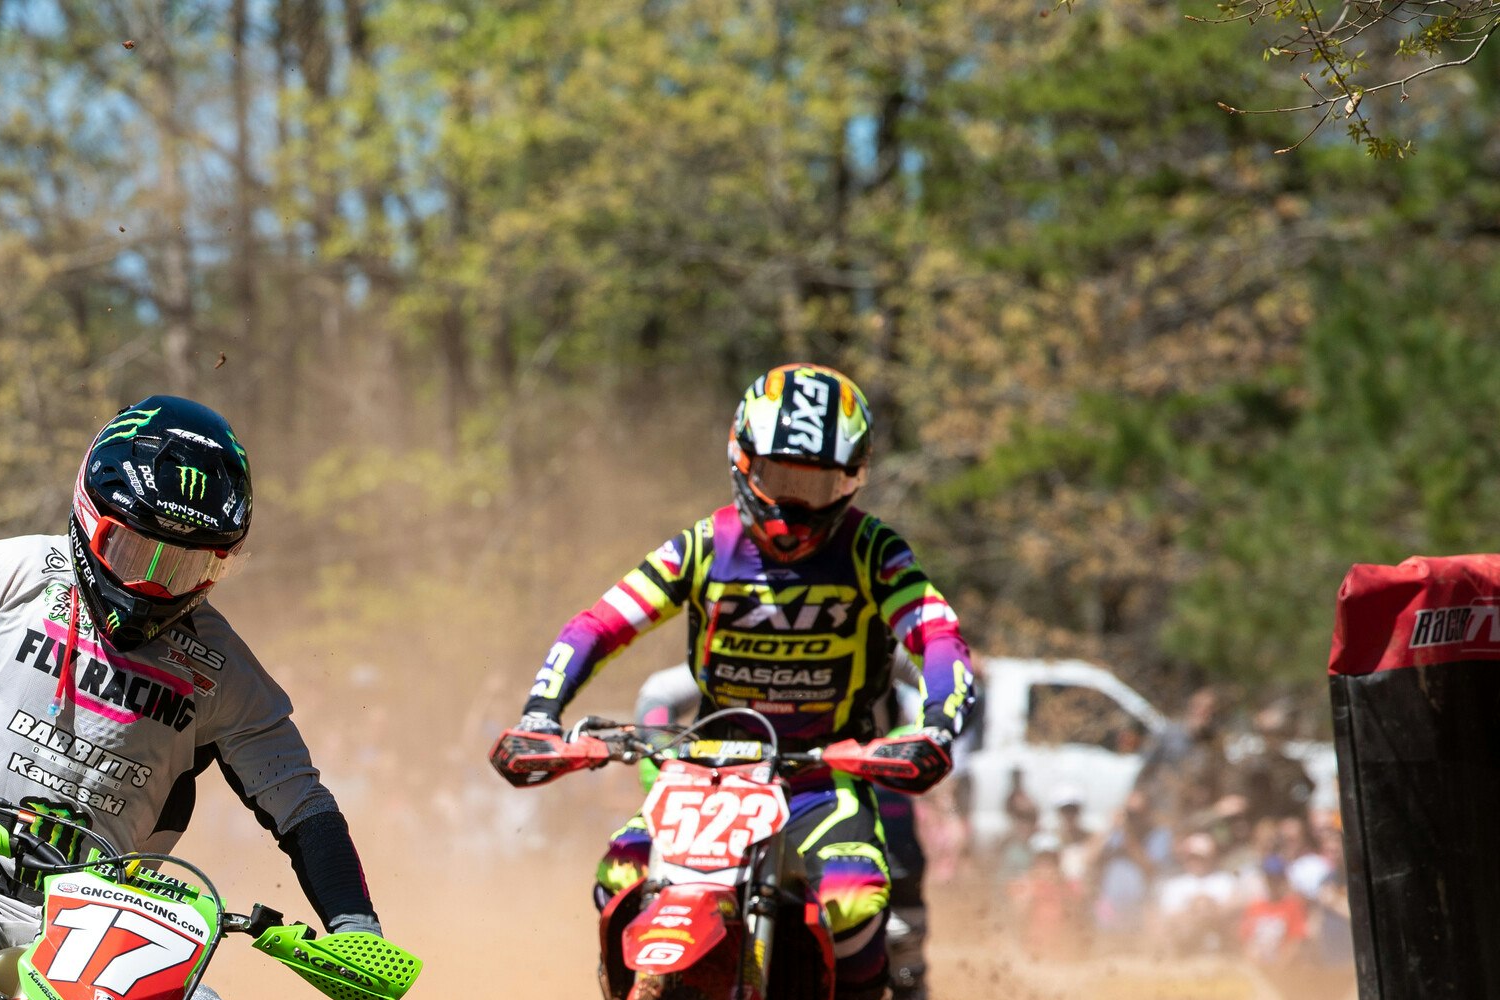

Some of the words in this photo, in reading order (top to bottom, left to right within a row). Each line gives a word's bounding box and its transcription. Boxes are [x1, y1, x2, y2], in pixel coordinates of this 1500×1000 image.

[787, 376, 830, 455] FXR
[156, 499, 219, 527] MONSTER
[165, 509, 210, 528] ENERGY
[705, 581, 858, 630] FXR
[15, 628, 81, 679] FLY
[169, 629, 226, 671] WPS
[720, 635, 832, 655] MOTO
[78, 656, 197, 733] RACING
[714, 663, 833, 686] GASGAS
[6, 709, 153, 788] BABBITT'S
[33, 746, 120, 790] ONLINE
[6, 752, 127, 817] Kawasaki
[657, 790, 780, 858] 523
[80, 886, 205, 938] GNCCRACING.COM
[45, 903, 199, 998] 17
